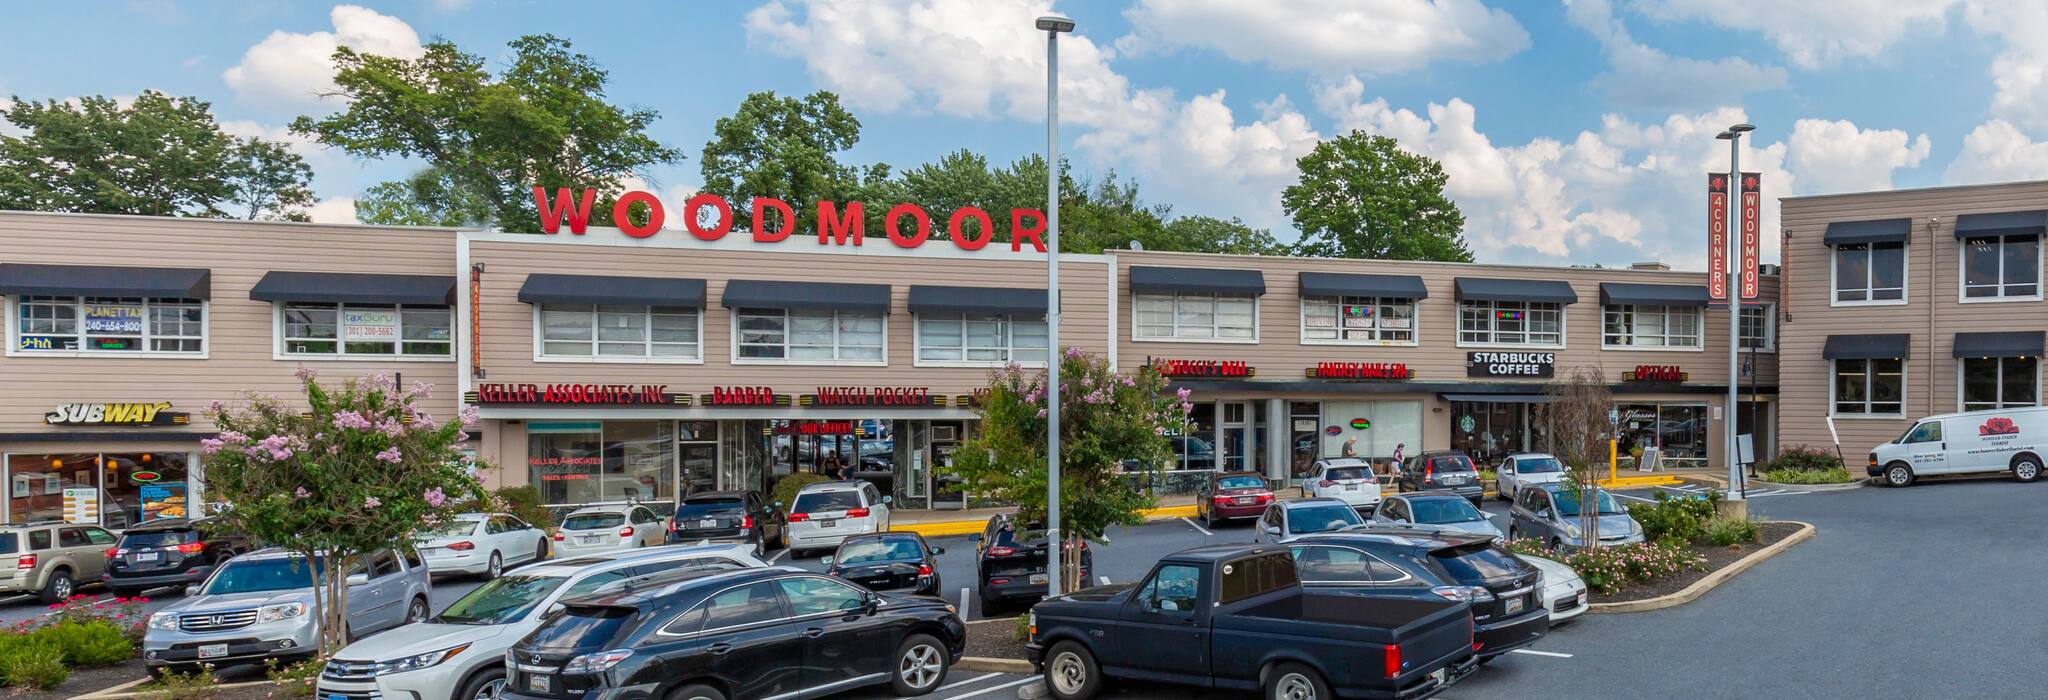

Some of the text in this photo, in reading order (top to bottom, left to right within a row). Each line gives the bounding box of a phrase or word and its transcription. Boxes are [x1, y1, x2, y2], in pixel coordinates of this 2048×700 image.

[532, 185, 1048, 253] WOODMOOR
[1745, 195, 1755, 295] WOODMOOR
[85, 307, 142, 317] PLANET TAX
[1474, 352, 1554, 364] STARBUCKS
[1221, 360, 1247, 376] DELI
[1318, 361, 1407, 378] FANTASY NAILS SPA
[1489, 363, 1539, 375] COFFEE
[1635, 365, 1681, 382] OPTICAL
[479, 383, 667, 404] KELLER ASSOCIATES INC
[713, 386, 773, 406] BARBER
[817, 386, 929, 406] WATCH POCKET
[47, 401, 172, 423] SUBWAY
